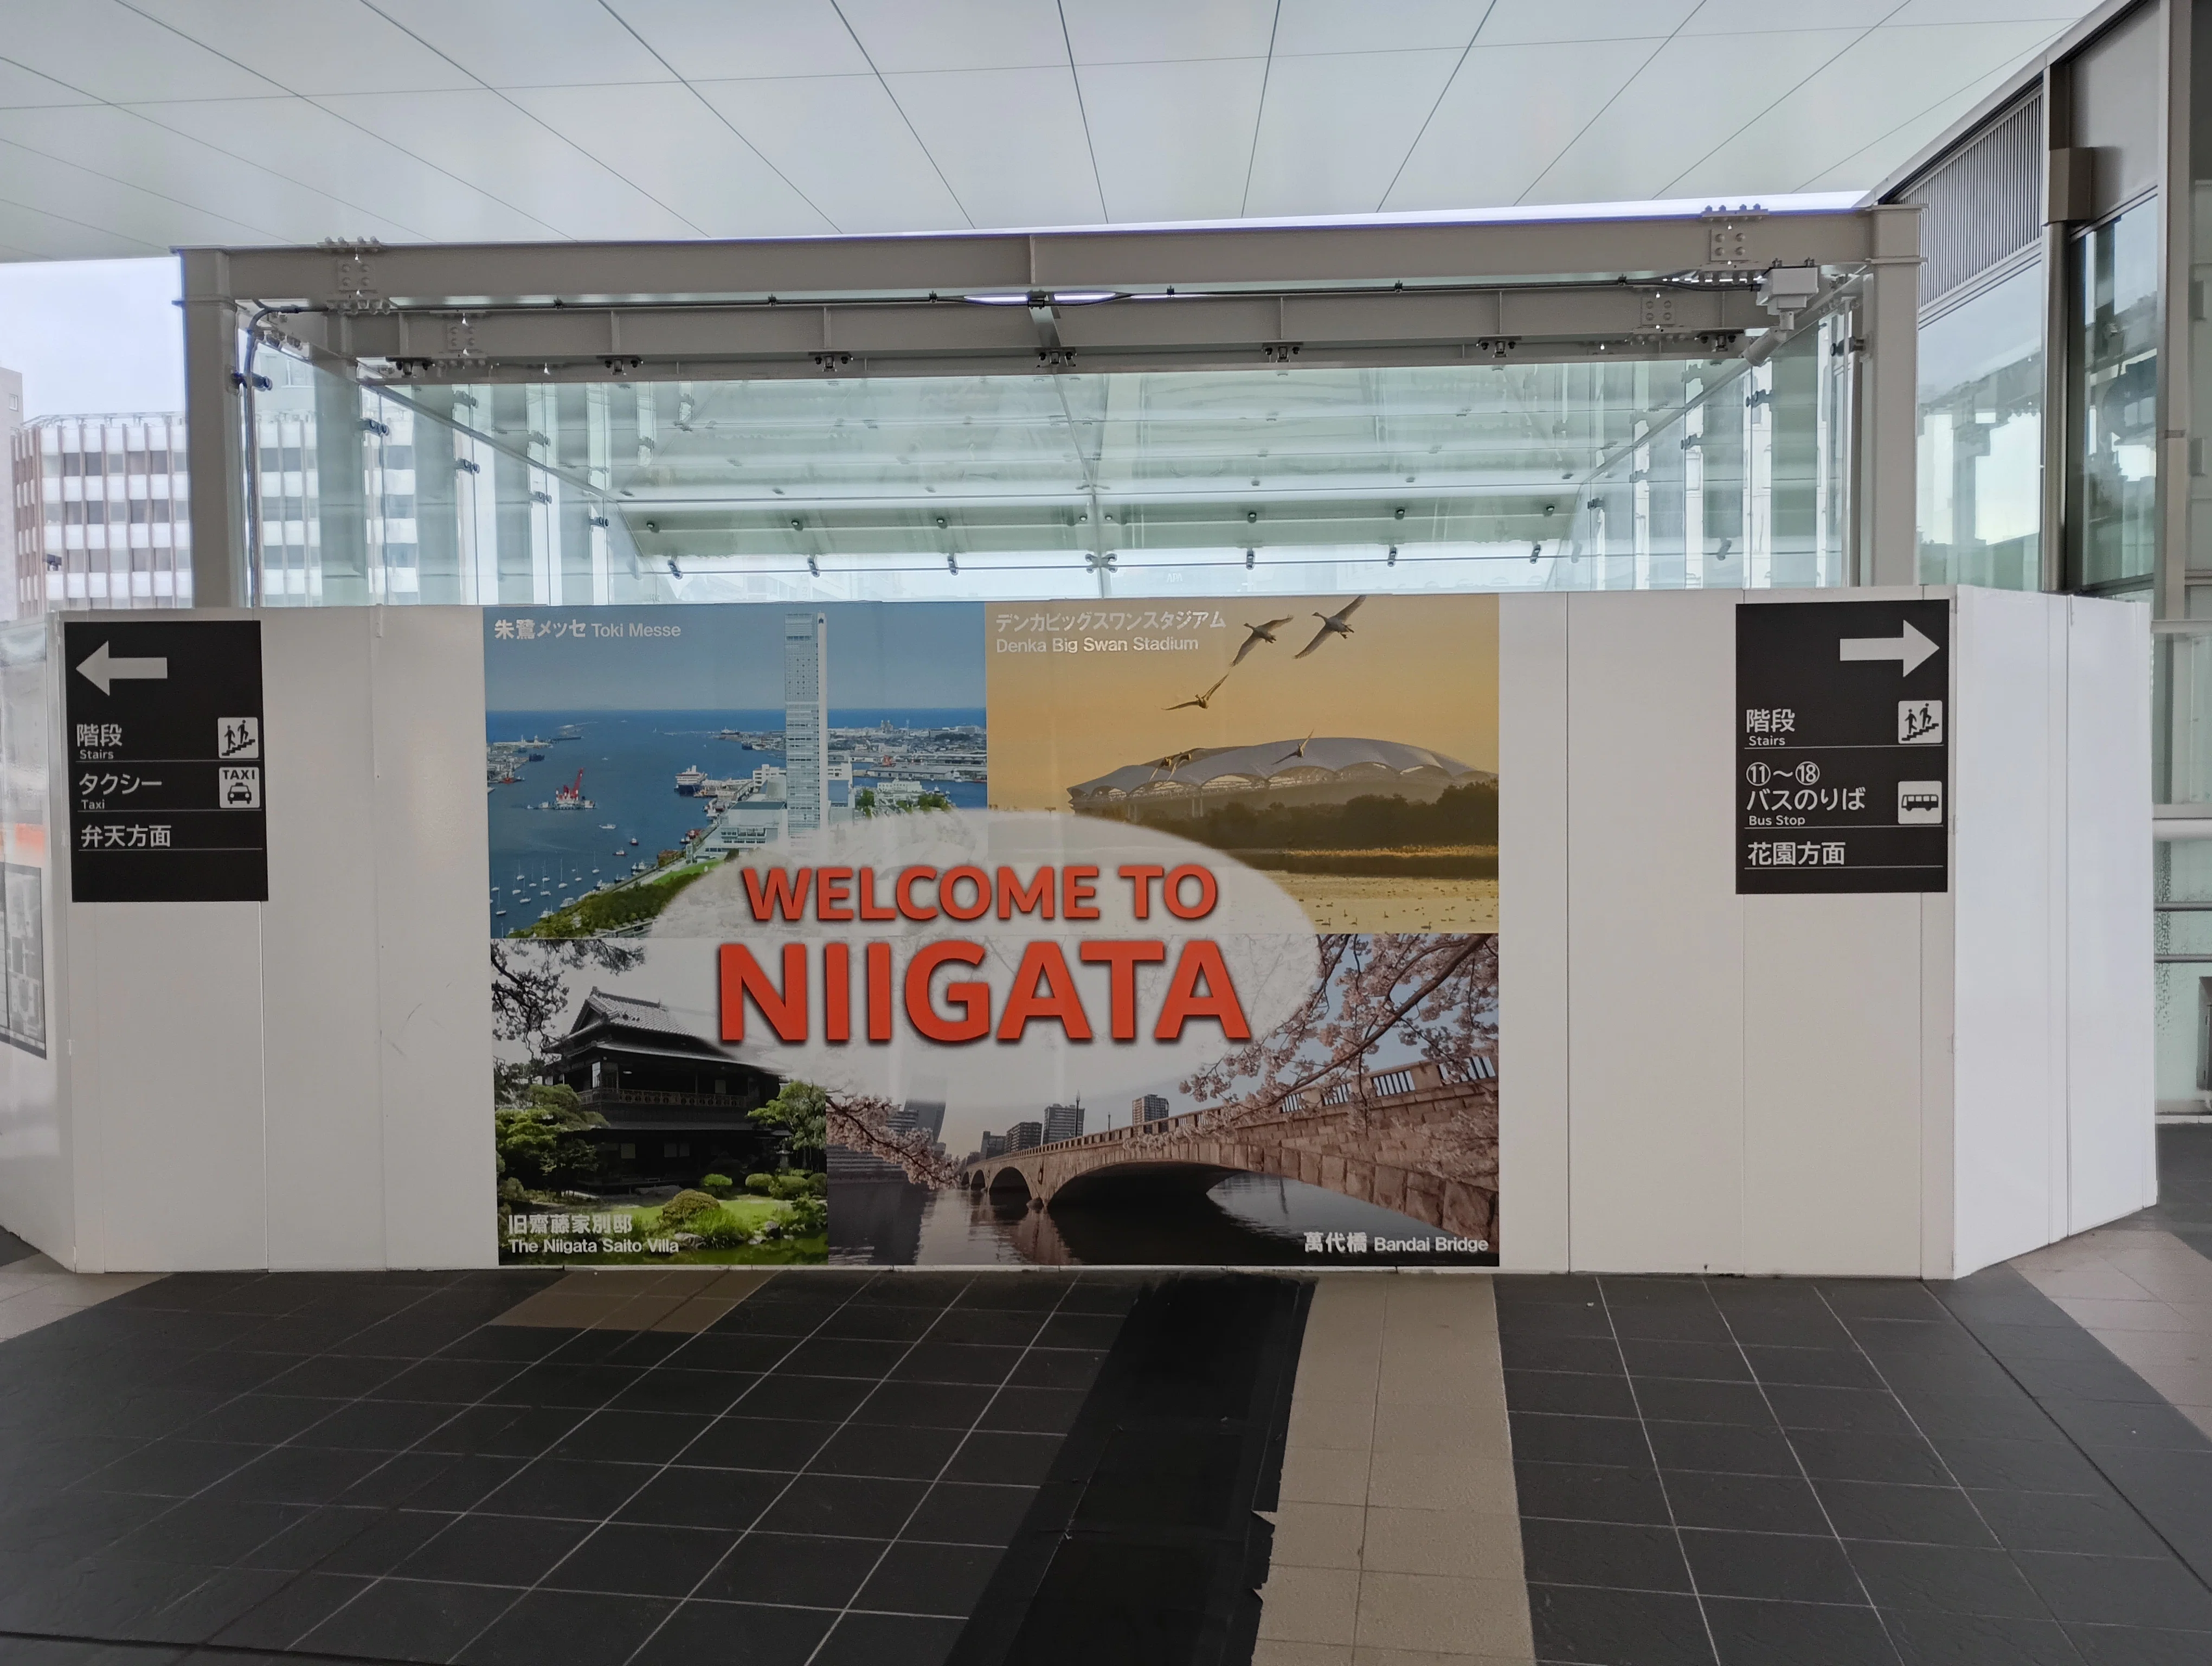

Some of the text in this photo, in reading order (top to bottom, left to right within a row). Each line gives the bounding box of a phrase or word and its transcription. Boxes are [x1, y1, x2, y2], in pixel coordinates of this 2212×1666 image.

[494, 619, 681, 640] 朱鷺メッセ Toki Messe
[996, 611, 1227, 633] デンカビッグスワンスタジアム
[996, 636, 1199, 653] Denka Big Swan Stadium
[1746, 708, 1796, 733] 階段
[76, 723, 123, 747] 階段
[1748, 735, 1785, 746] Stairs
[80, 749, 114, 760] Stairs
[79, 773, 163, 795] タクシー
[222, 770, 255, 780] TAXI
[81, 799, 105, 810] Taxi
[1746, 786, 1866, 811] バスのりば
[1749, 815, 1805, 827] Bus Stop
[80, 824, 172, 848] 弁天方面
[1747, 842, 1846, 866] 花園方面
[743, 864, 1218, 920] WELCOME TO
[718, 940, 1252, 1042] NIIGATA
[509, 1239, 679, 1255] The Niigata Saito Villa
[1303, 1232, 1489, 1253] 萬代橋 Bandai Bridge
